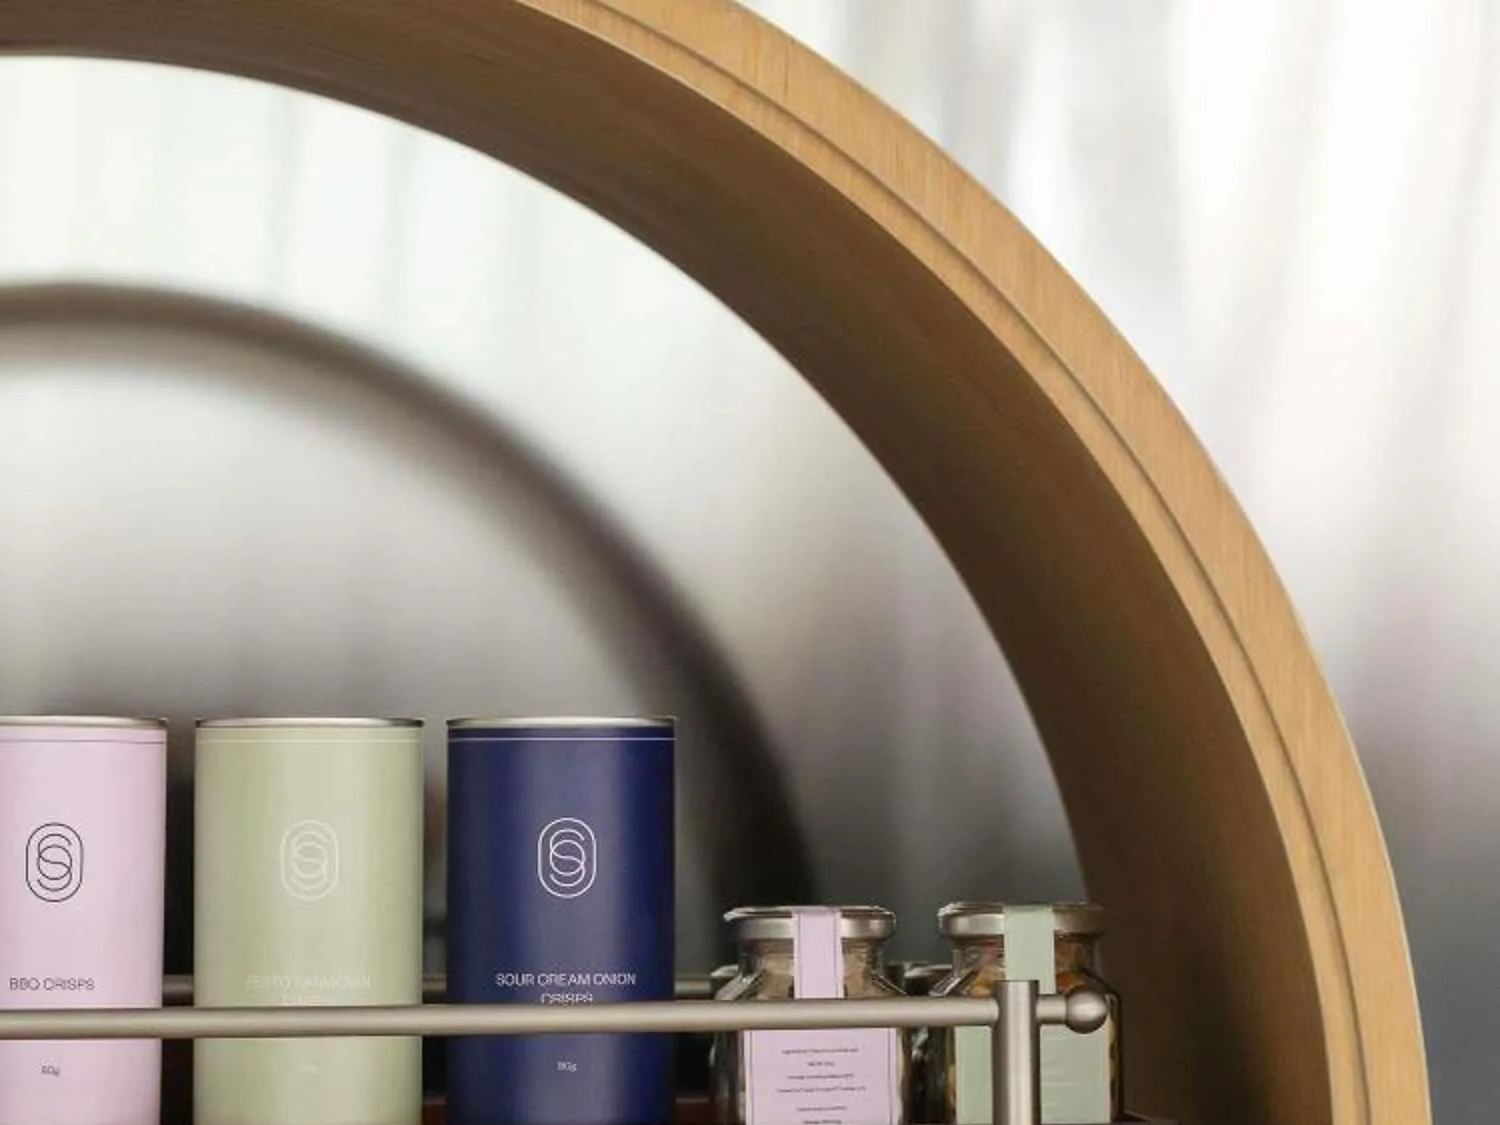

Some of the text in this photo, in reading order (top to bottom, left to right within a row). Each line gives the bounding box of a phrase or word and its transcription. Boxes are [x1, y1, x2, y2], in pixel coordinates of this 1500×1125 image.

[8, 976, 95, 992] BBQ CRISPS
[494, 972, 637, 987] SOUR CREAM ONION
